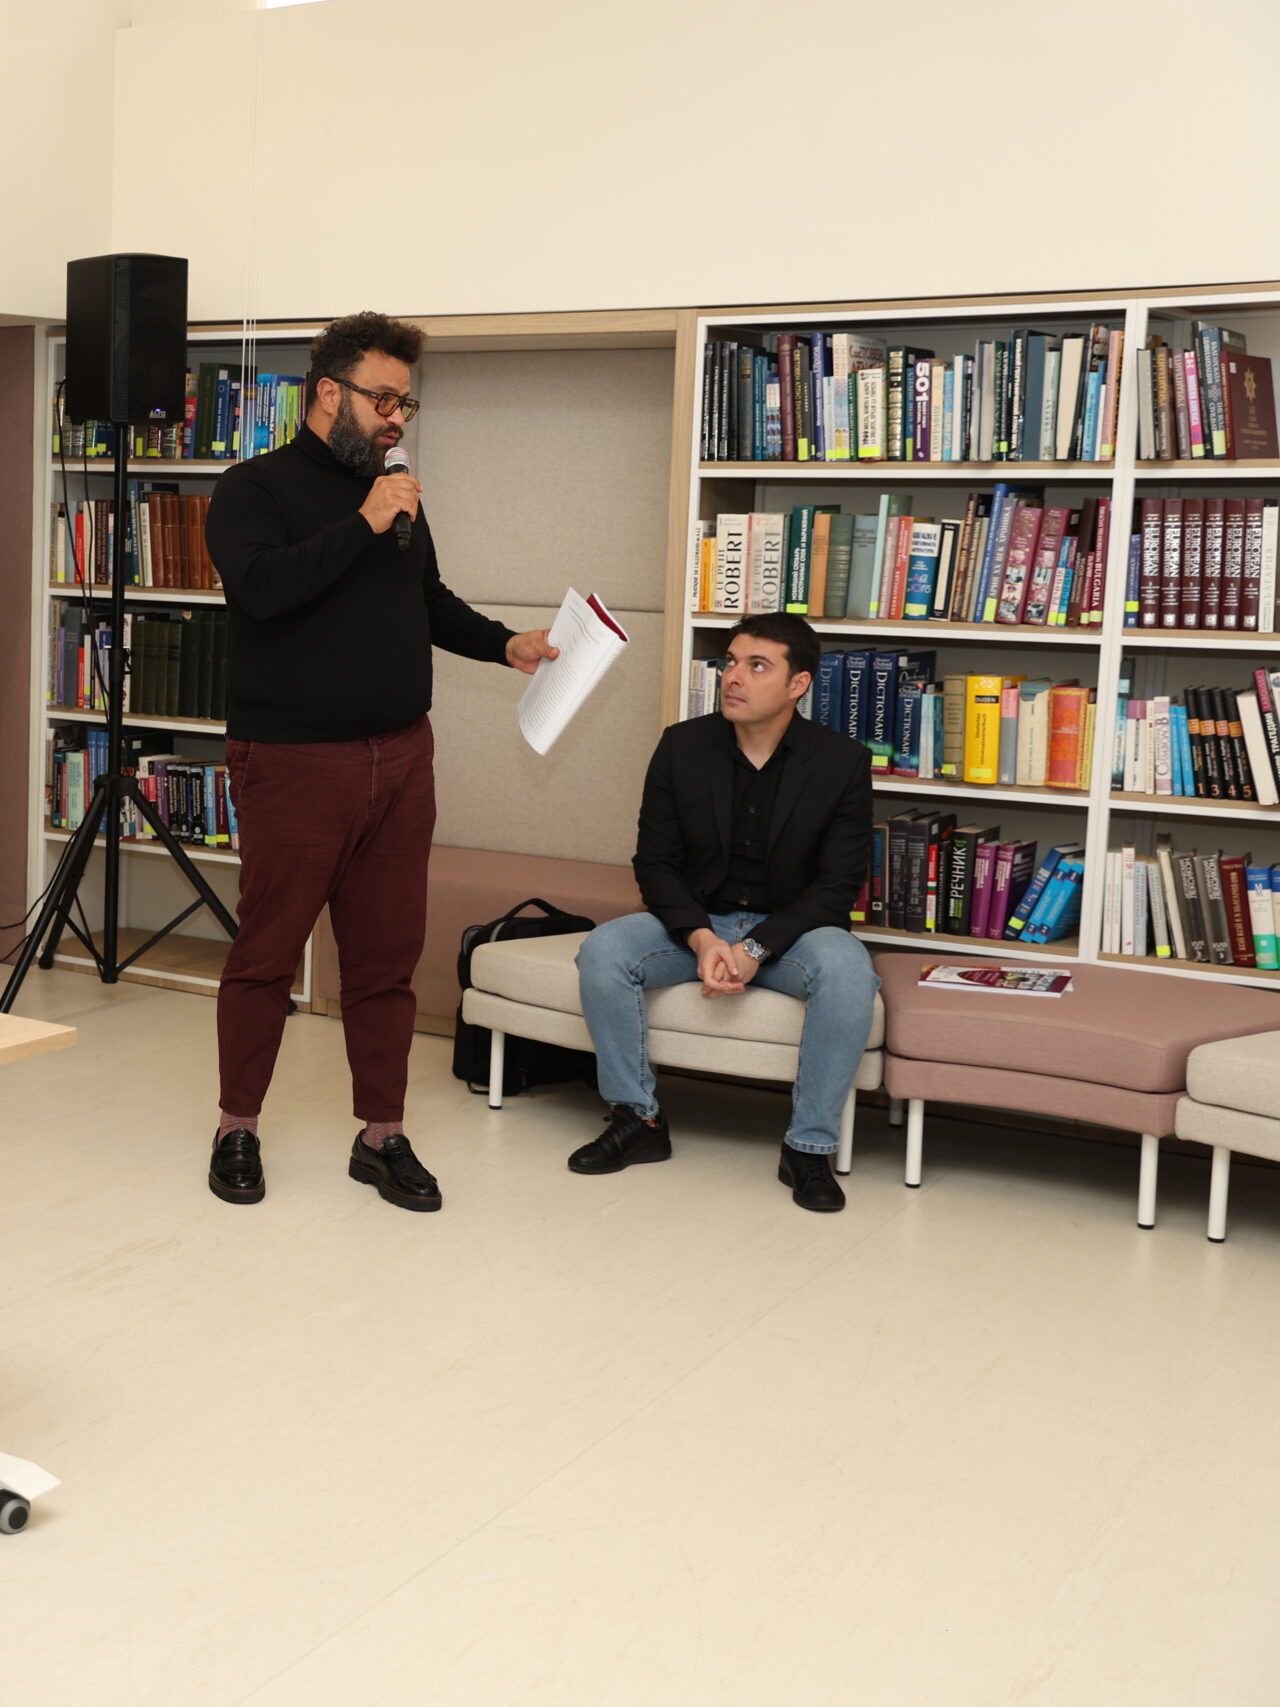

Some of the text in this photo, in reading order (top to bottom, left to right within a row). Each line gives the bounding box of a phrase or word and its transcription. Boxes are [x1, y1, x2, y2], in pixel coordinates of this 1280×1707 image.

[915, 361, 930, 402] 501
[998, 506, 1012, 543] ХРОНИКА
[716, 549, 725, 590] LE PETIT
[724, 530, 742, 608] ROBERT
[761, 531, 780, 608] ROBERT
[1150, 527, 1160, 577] EUROPEAN
[1170, 527, 1181, 577] EUROPEAN
[1191, 527, 1201, 577] EUROPEAN
[1212, 527, 1222, 577] EUROPEAN
[1232, 527, 1243, 577] EUROPEAN
[1251, 527, 1262, 577] EUROPEAN
[1091, 563, 1102, 606] BULGARIA
[819, 668, 832, 726] DICTIONA
[848, 670, 861, 740] DICTIONARY
[874, 672, 888, 743] DICTIONARY
[902, 698, 914, 759] DICTIONARY
[1265, 712, 1280, 754] ТРАГЕДИИ
[1197, 783, 1205, 794] 1
[1211, 784, 1220, 796] 3
[1228, 785, 1237, 796] 4
[1243, 786, 1252, 798] 5
[950, 847, 967, 898] РЕЧНИК
